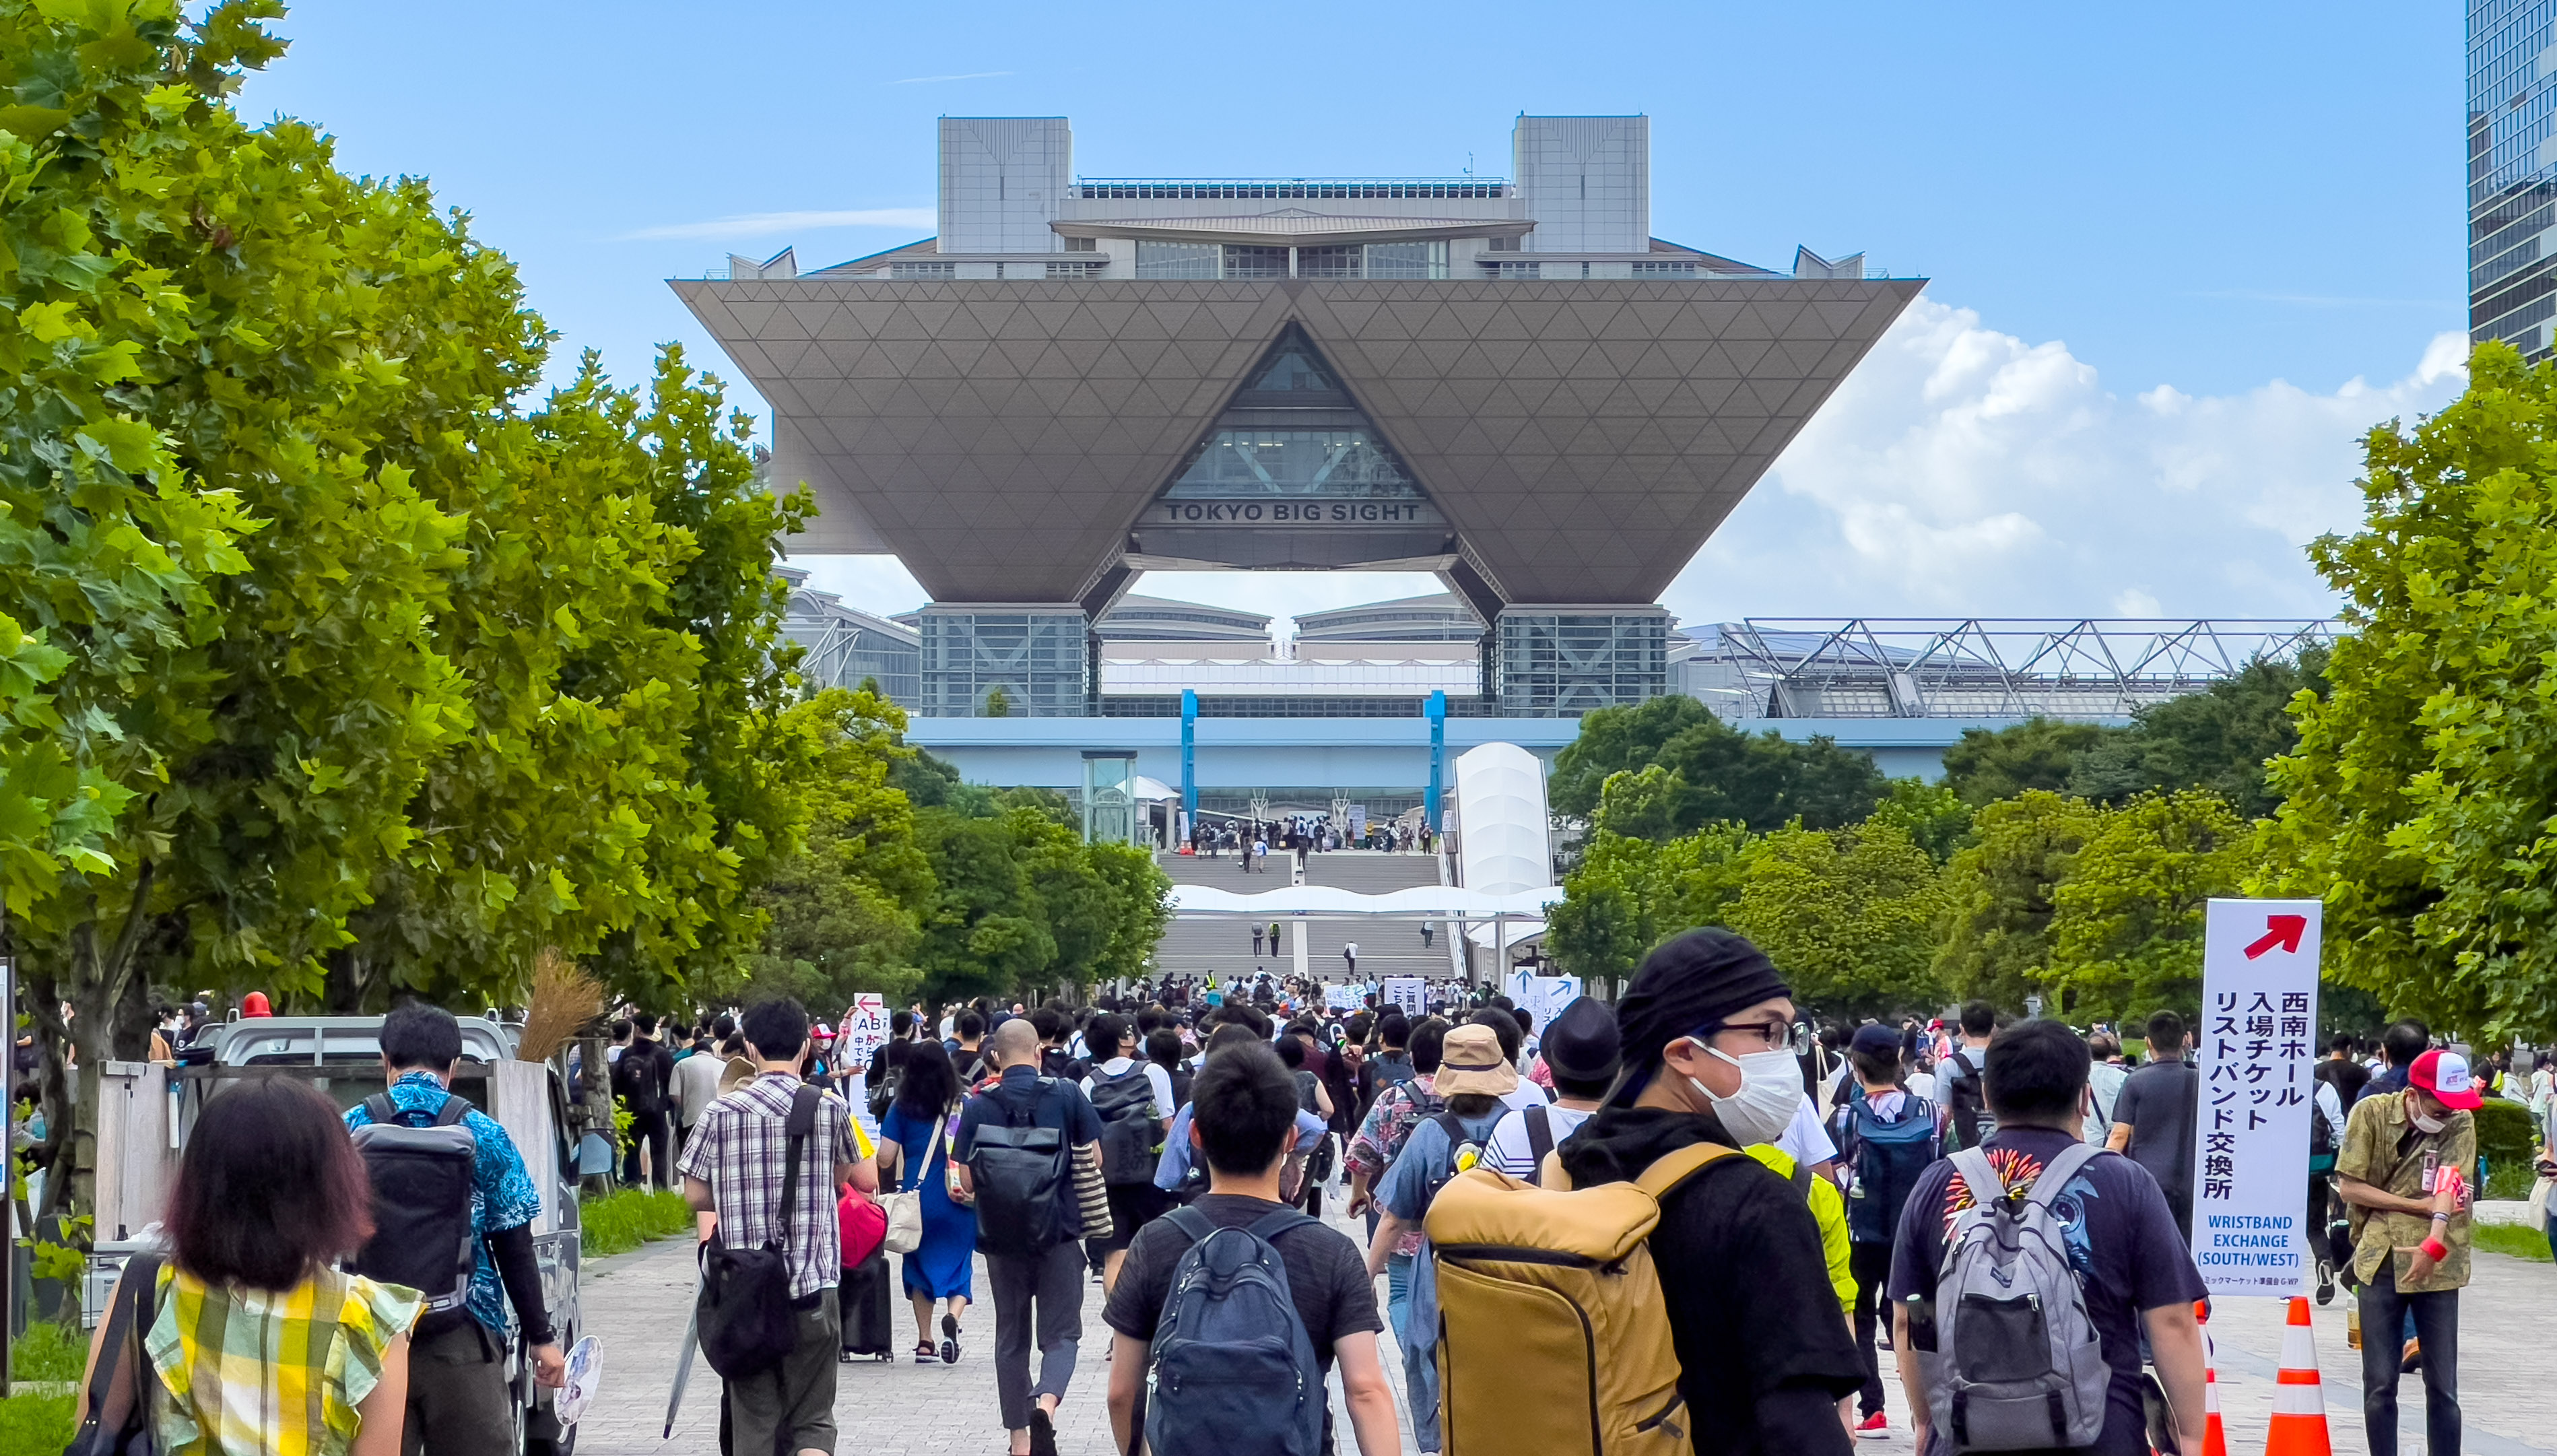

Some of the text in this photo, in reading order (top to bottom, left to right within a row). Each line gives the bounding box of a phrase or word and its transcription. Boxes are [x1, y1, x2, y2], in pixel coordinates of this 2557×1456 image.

[1166, 504, 1420, 521] TOKYO BIG SIGHT
[2276, 992, 2309, 1107] 西南ホール
[2244, 992, 2275, 1131] 入場チケット
[2203, 992, 2240, 1200] リストバンド交換所
[2208, 1215, 2292, 1229] WRISTBAND
[2214, 1234, 2289, 1248] EXCHANGE
[2198, 1251, 2299, 1268] (SOUTH/WEST)
[2203, 1276, 2280, 1286] ミックマーケット準備会
